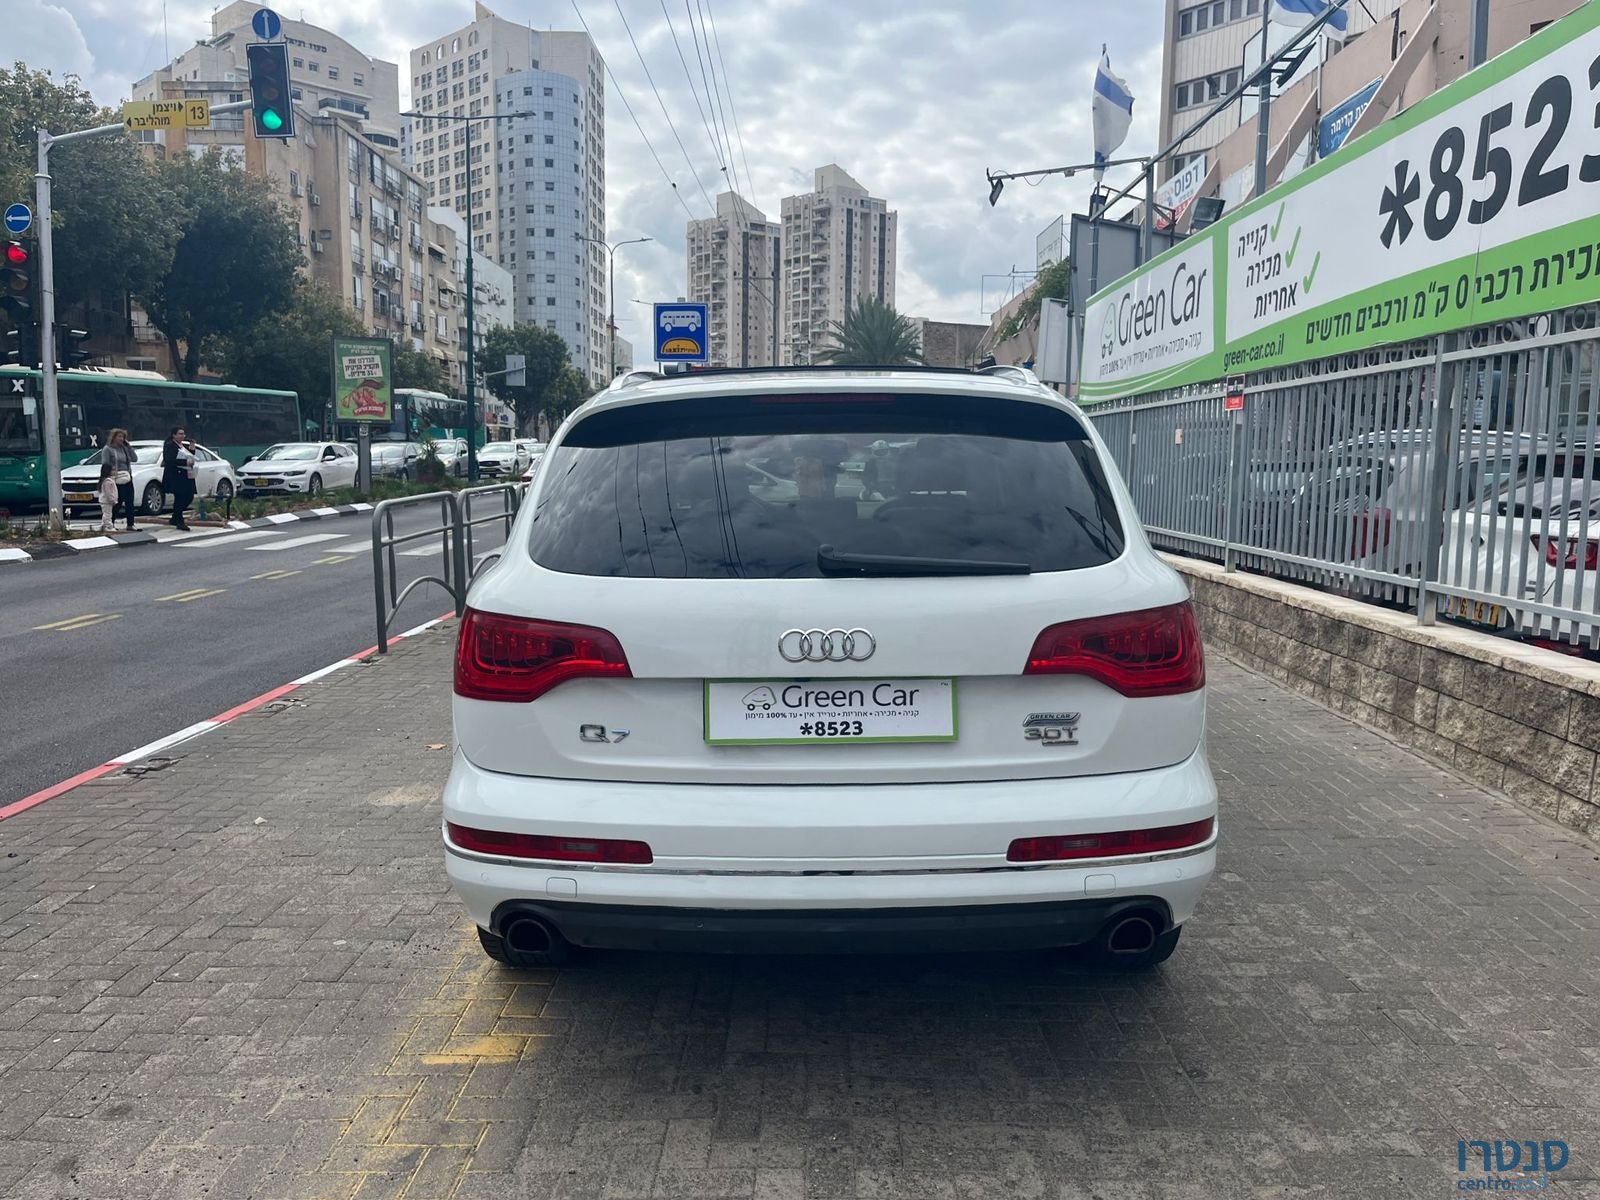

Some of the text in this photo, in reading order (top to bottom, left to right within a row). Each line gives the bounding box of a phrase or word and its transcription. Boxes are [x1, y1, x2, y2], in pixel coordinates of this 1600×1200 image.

[134, 114, 171, 126] מוהליבר
[153, 103, 177, 115] ויצמן
[191, 106, 205, 120] 13
[1331, 111, 1354, 135] קדימה
[1175, 165, 1199, 197] דפוס
[1238, 224, 1268, 258] קנייה
[1246, 253, 1281, 288] מכירה
[1530, 243, 1600, 291] כירת
[1253, 282, 1298, 319] אחריות
[1475, 265, 1523, 304] רכבי
[1118, 262, 1207, 346] Green Car
[1356, 296, 1408, 333] ורכבים
[1306, 312, 1352, 344] חדשים
[1224, 333, 1285, 371] green-car.co.il
[782, 683, 920, 708] Green Car
[745, 712, 764, 720] מימון
[804, 711, 815, 719] אין
[902, 710, 919, 718] קניה
